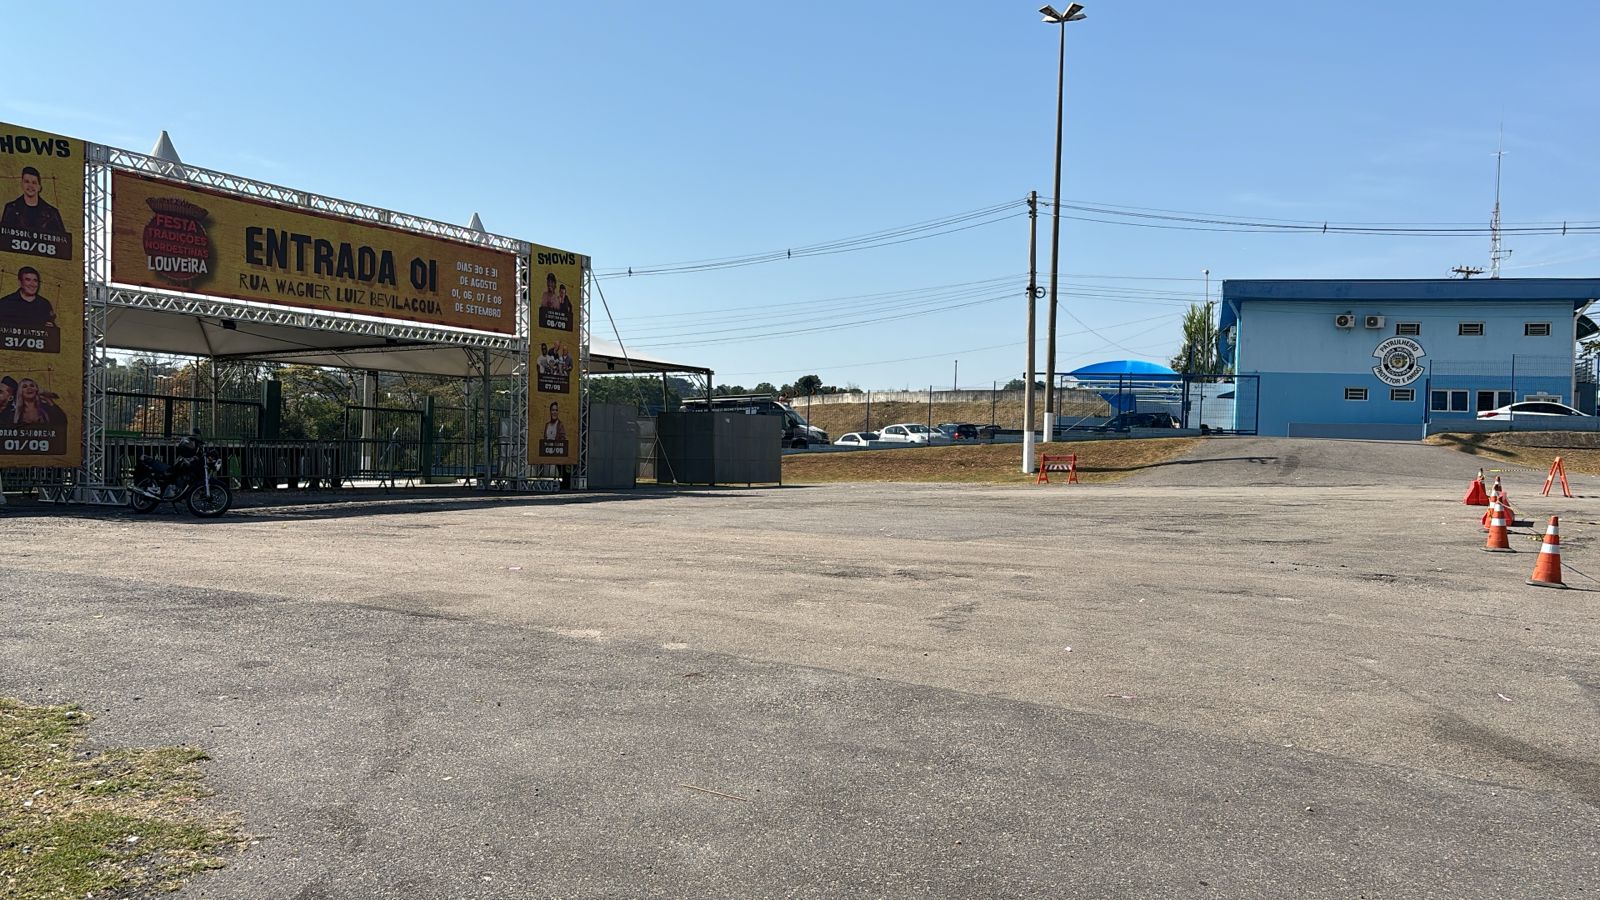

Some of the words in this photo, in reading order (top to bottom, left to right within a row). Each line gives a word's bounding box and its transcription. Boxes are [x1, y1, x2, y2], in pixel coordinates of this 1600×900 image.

[0, 135, 71, 157] HOWS
[156, 213, 196, 232] FESTA
[11, 239, 56, 255] 30/08
[245, 226, 396, 286] ENTRADA
[538, 252, 576, 265] SHOWS
[456, 261, 472, 273] DIAS
[474, 265, 484, 275] 30
[485, 268, 490, 276] E
[460, 276, 469, 286] DE
[471, 278, 497, 291] AGOSTO
[239, 273, 270, 292] RUA
[275, 278, 331, 301] WAGNER
[336, 287, 366, 305] LUIZ
[370, 291, 442, 315] BEVILACQUA
[476, 293, 485, 303] 07
[487, 294, 492, 303] E
[493, 295, 502, 305] 08
[455, 302, 464, 313] DE
[466, 304, 501, 318] SETEMBRO
[4, 336, 45, 350] 31/08
[1379, 339, 1419, 353] PATRULHEIRO
[1376, 366, 1401, 384] PROTETOR
[1406, 366, 1422, 382] AMIGO
[0, 429, 18, 437] ORRO
[4, 439, 50, 452] 01/09
